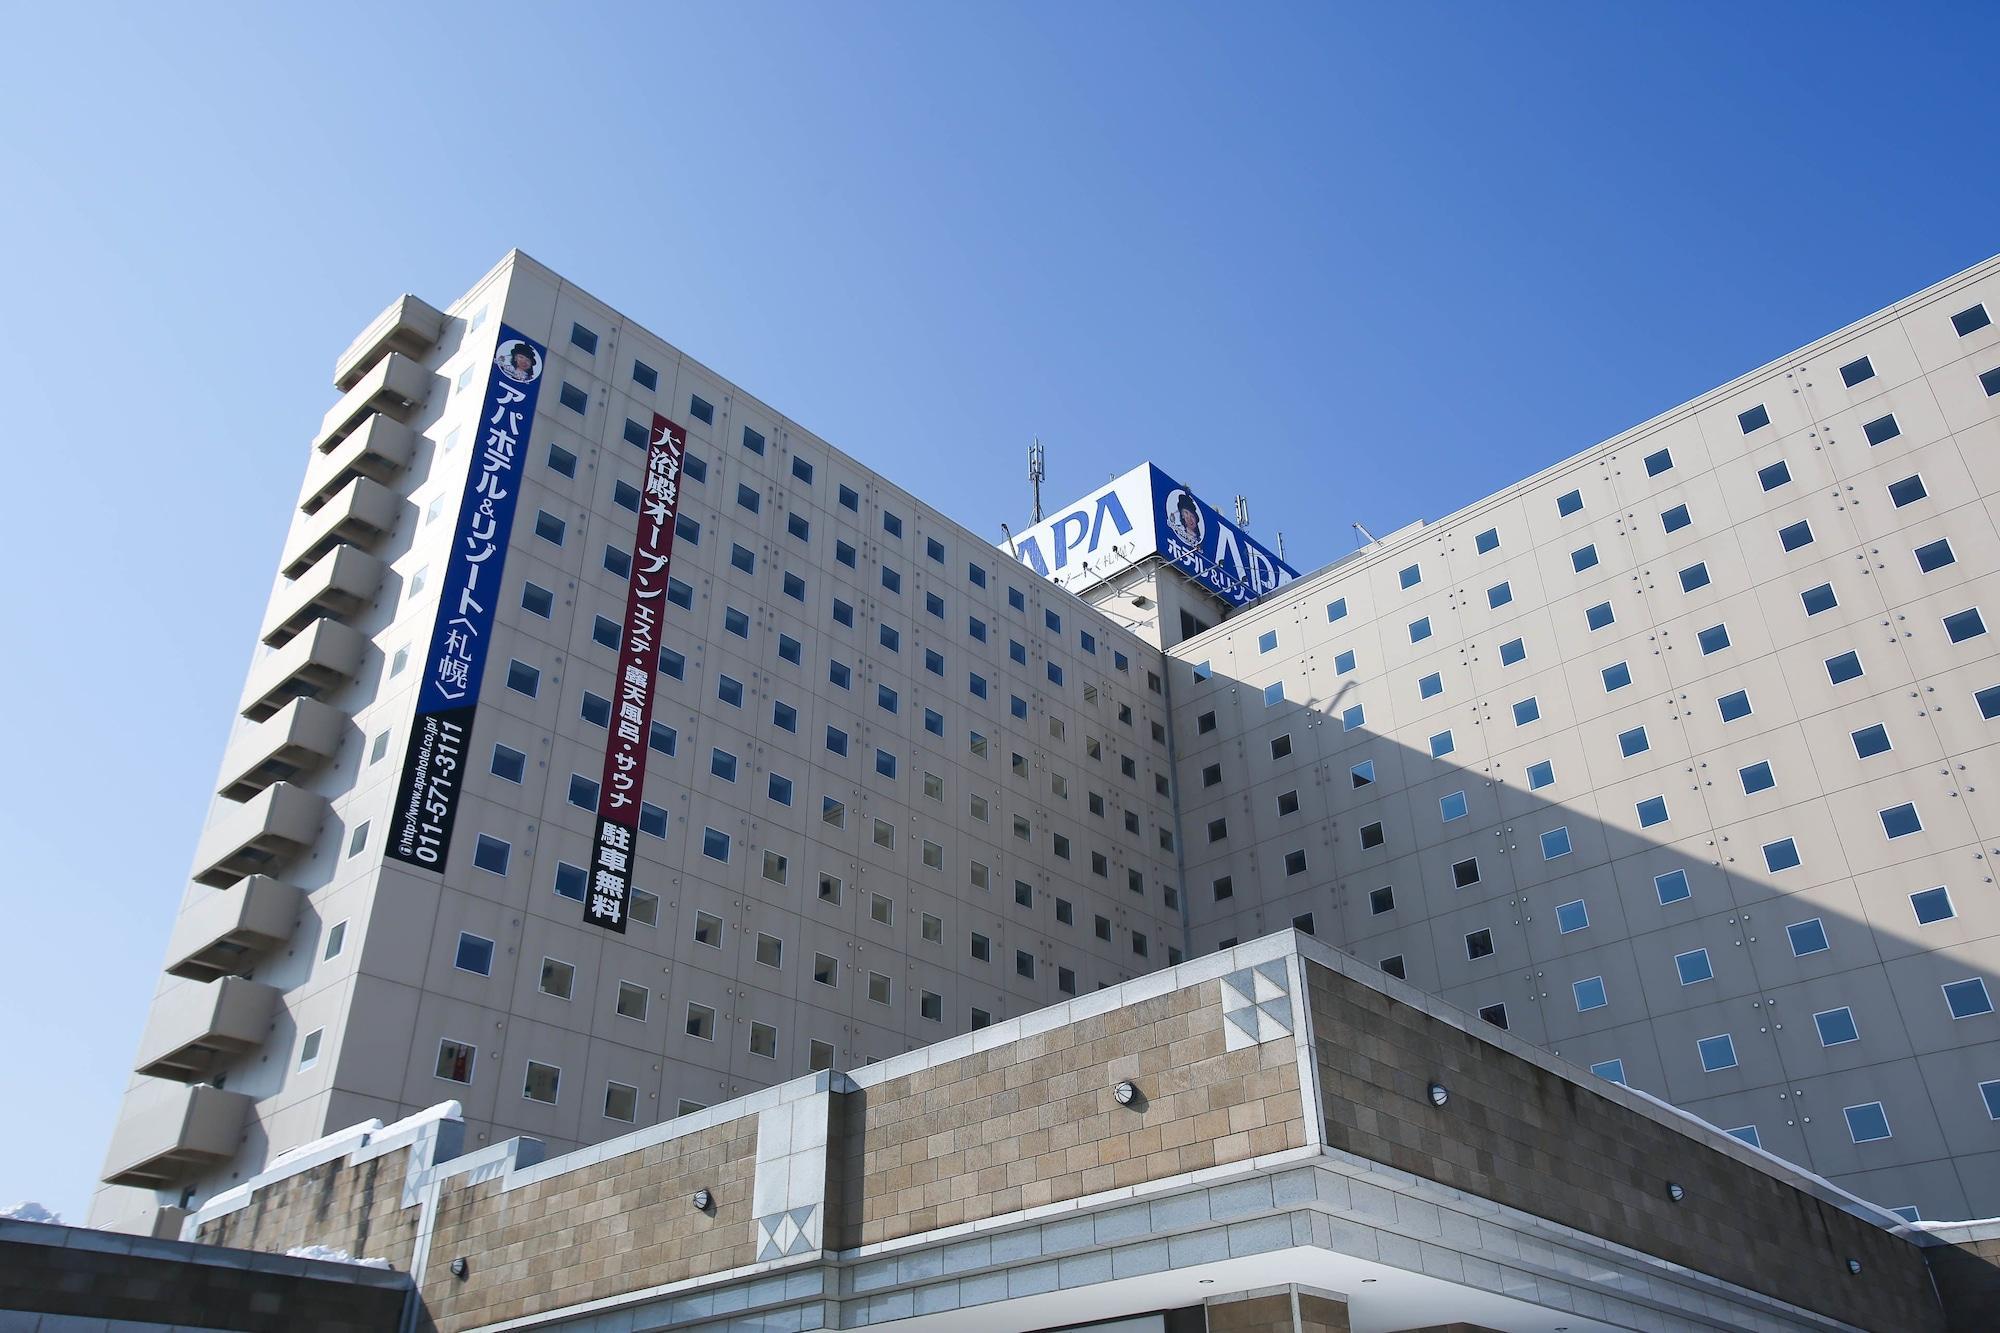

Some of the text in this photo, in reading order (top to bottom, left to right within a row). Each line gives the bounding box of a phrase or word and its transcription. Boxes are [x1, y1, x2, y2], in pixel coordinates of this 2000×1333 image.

[635, 427, 682, 599] 大浴殿オープン
[1016, 490, 1133, 578] APA
[415, 720, 463, 863] 011-571-3111
[591, 821, 631, 924] 駐車無料
